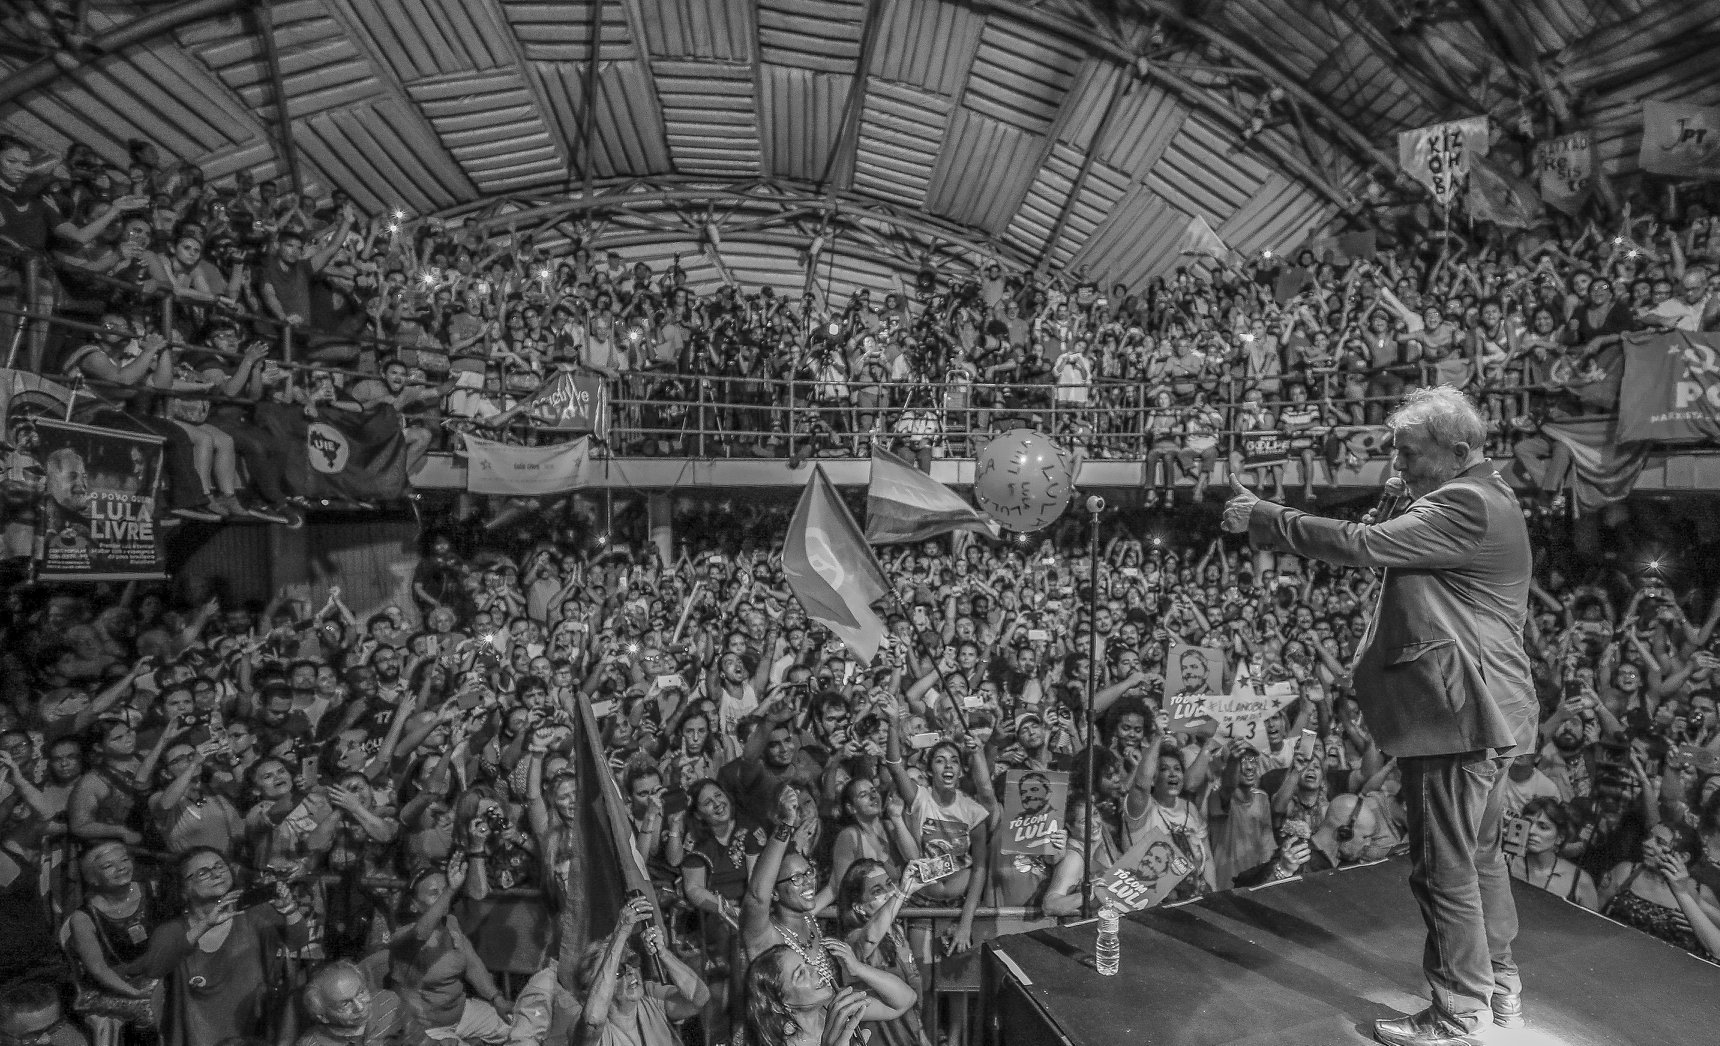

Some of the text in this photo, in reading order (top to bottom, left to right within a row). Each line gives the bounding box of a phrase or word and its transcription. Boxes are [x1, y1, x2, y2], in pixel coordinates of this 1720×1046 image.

[91, 500, 153, 522] LULA
[90, 519, 154, 541] LIVRE
[1009, 813, 1048, 830] TÔ COM
[1014, 819, 1058, 842] LULA
[1107, 880, 1149, 911] LULA
[1124, 877, 1148, 894] COM
